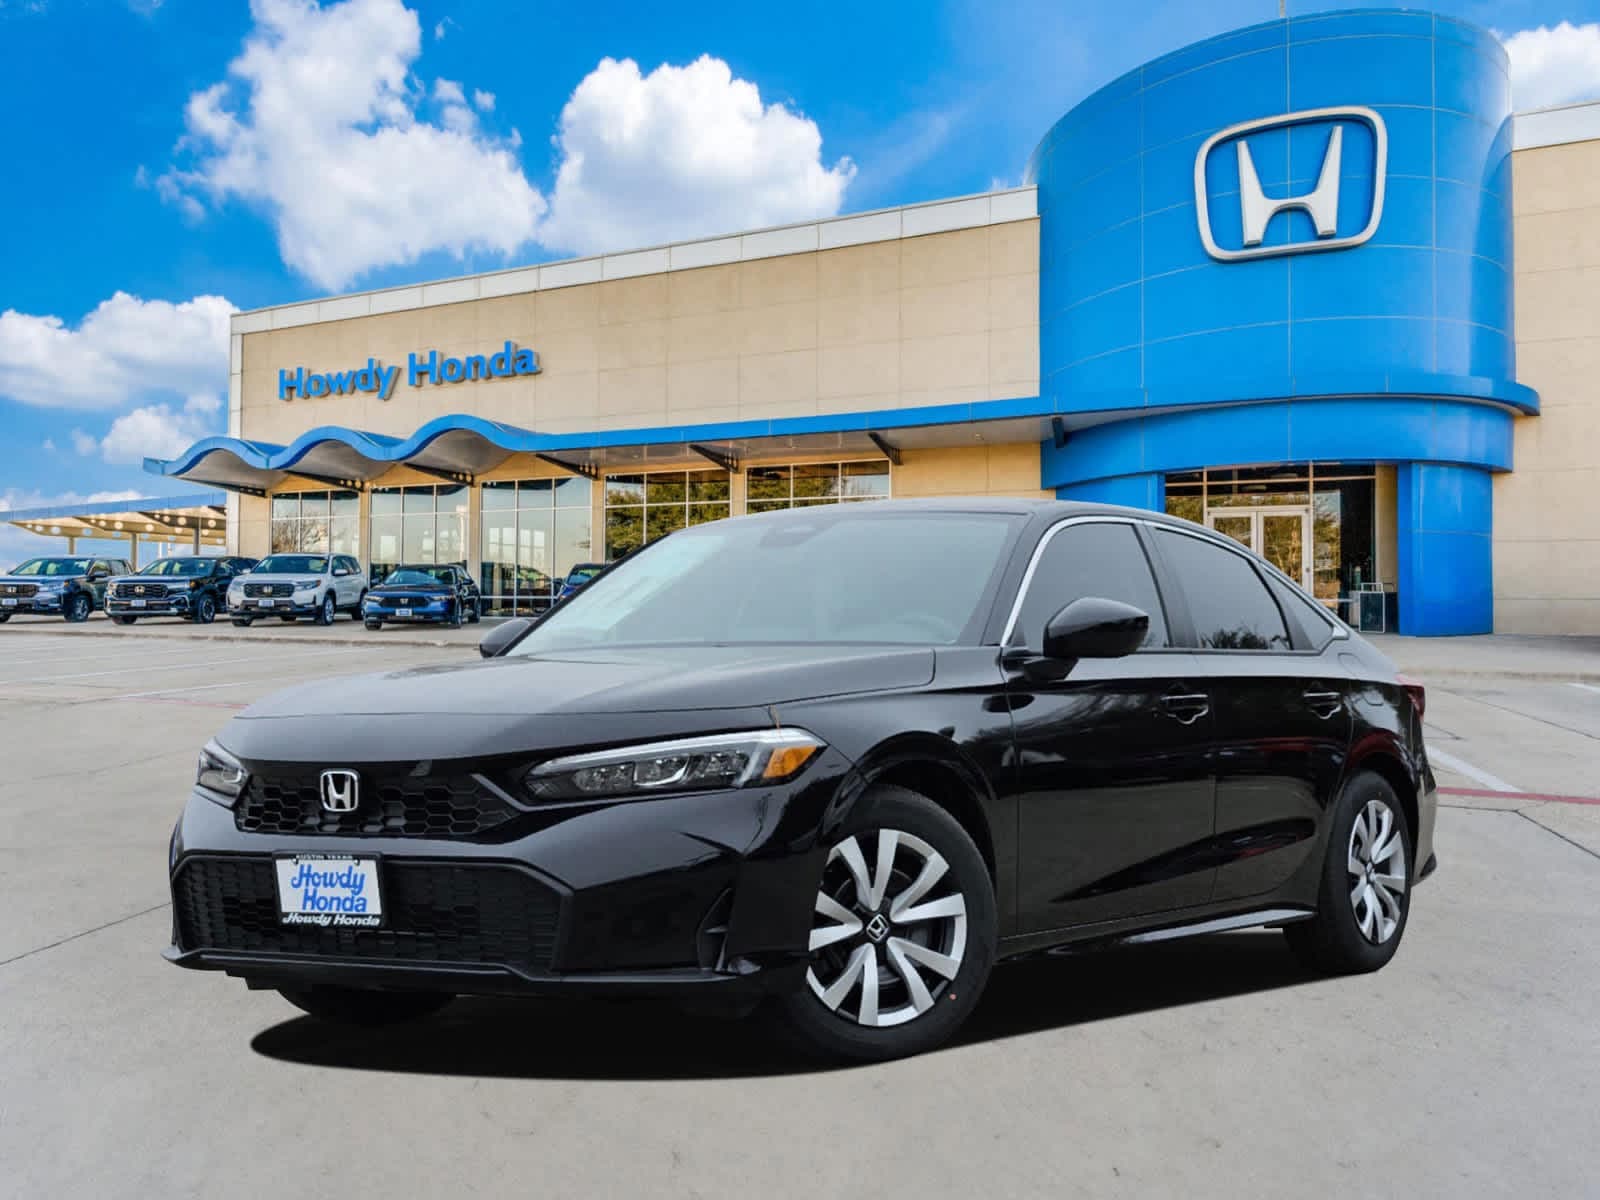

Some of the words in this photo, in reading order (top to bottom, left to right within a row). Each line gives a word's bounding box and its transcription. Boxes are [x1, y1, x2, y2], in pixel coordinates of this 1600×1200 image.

[279, 358, 398, 400] Howdy
[408, 340, 540, 388] Honda
[291, 864, 365, 896] Howdy
[302, 888, 367, 912] Honda
[282, 912, 332, 926] Howdy
[333, 914, 380, 926] Honda
